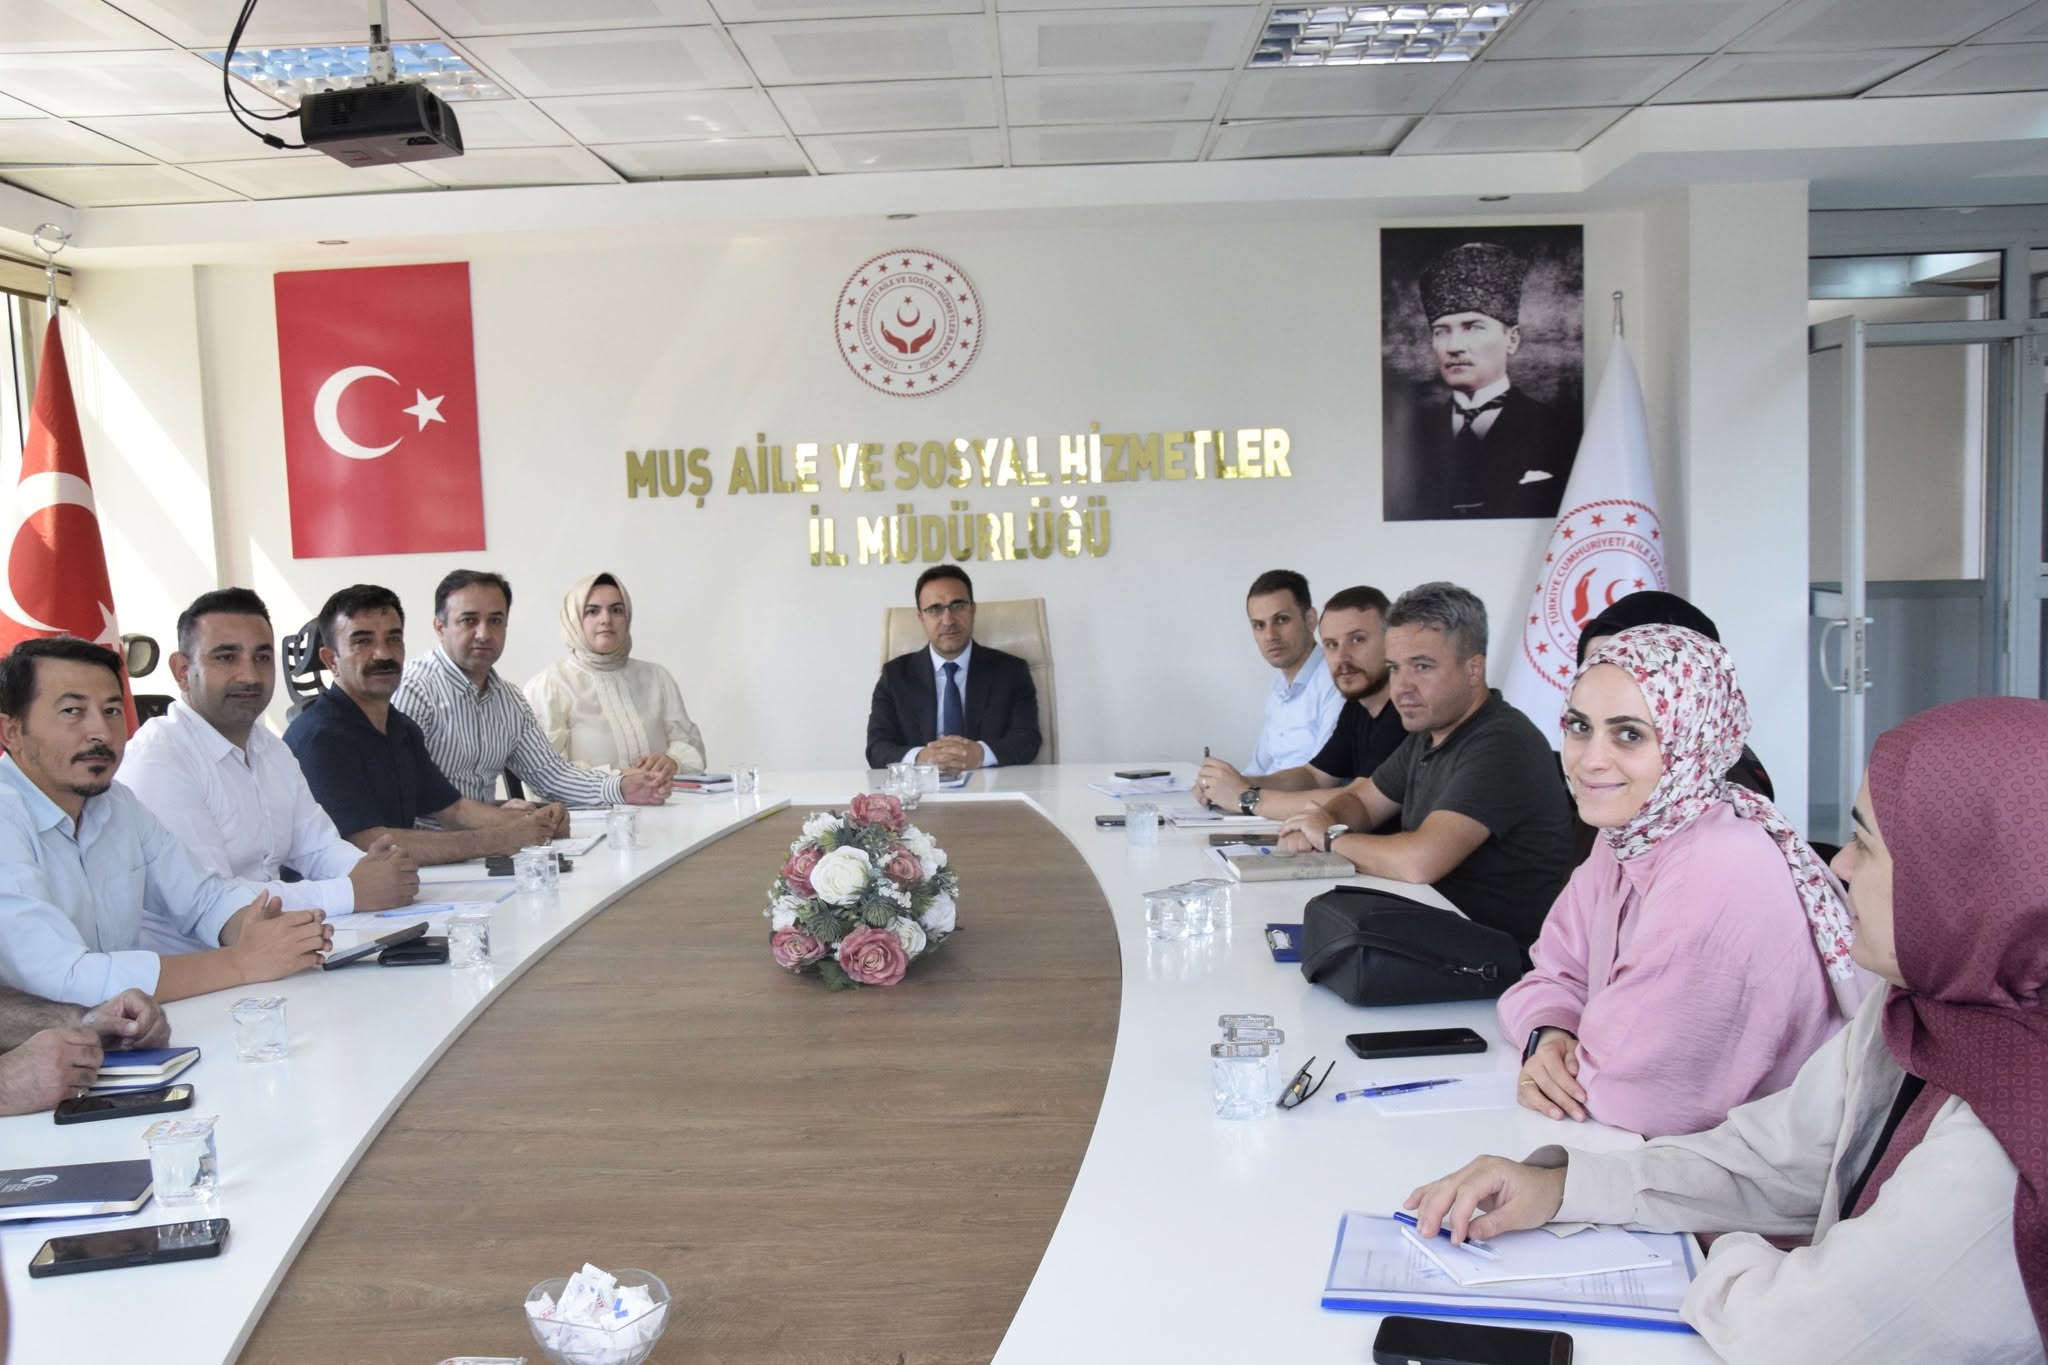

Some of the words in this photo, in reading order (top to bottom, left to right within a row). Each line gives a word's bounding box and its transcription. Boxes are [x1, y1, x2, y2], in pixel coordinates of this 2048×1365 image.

[908, 276, 937, 292] SOSYAL
[626, 448, 712, 508] MUŞ
[728, 433, 819, 494] AİLE
[832, 442, 884, 491] VE
[895, 436, 1050, 490] SOSYAL
[1060, 420, 1292, 484] HİZMETLER
[809, 504, 848, 566] İL
[857, 495, 1110, 565] MÜDÜRLÜĞÜ
[1548, 579, 1561, 625] TÜRKİYE
[1557, 536, 1626, 577] CUMHURİYETİ
[1627, 538, 1651, 557] AİLE
